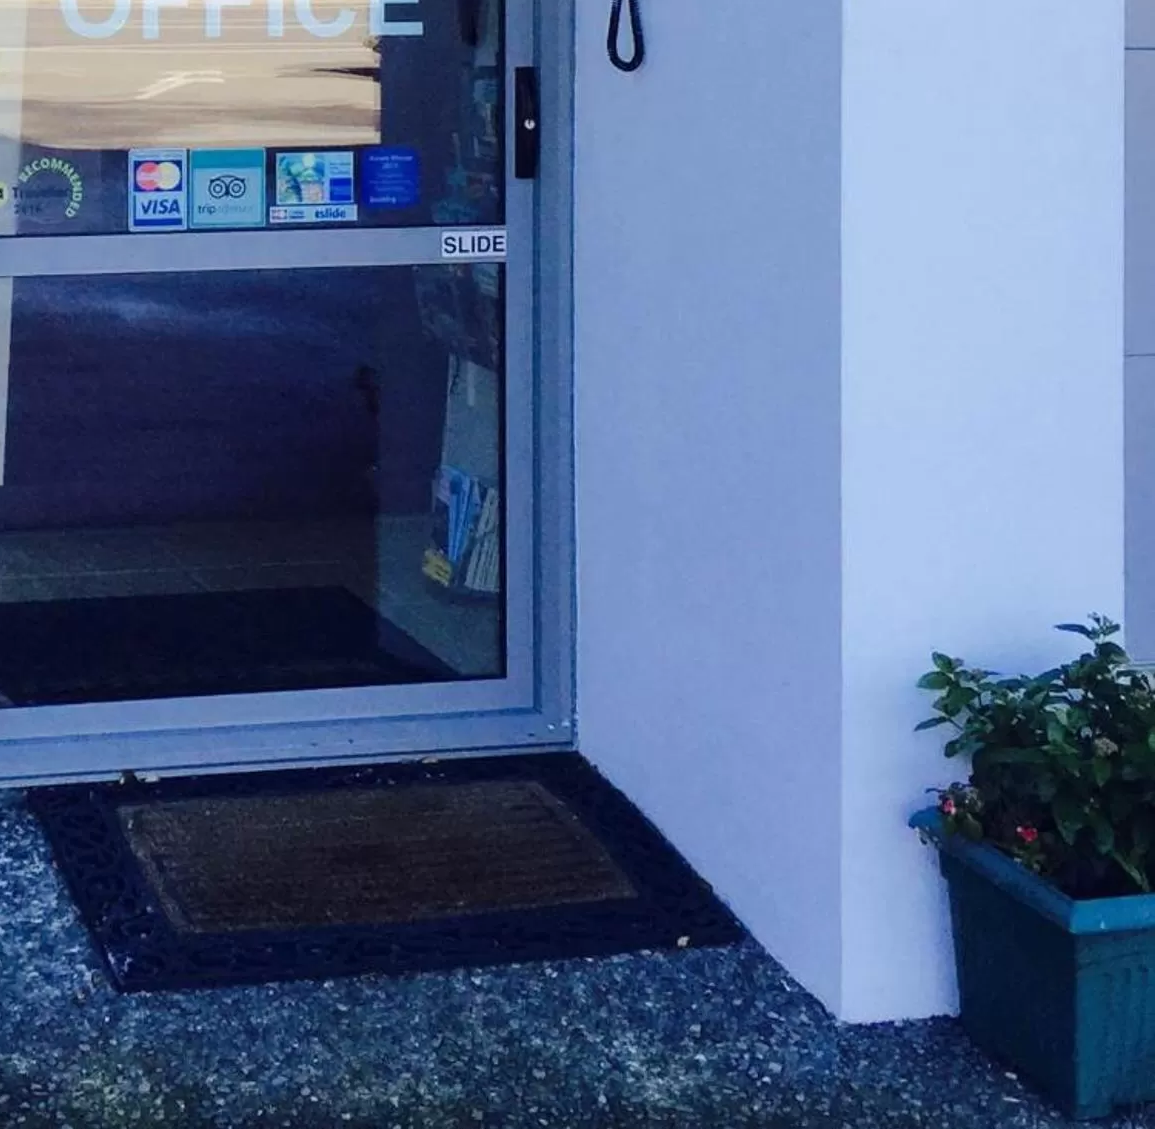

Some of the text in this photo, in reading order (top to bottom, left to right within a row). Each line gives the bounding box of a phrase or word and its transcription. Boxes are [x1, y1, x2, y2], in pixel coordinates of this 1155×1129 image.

[19, 157, 83, 219] RECOMMENDED
[140, 199, 182, 216] VISA
[444, 235, 505, 254] SLIDE
